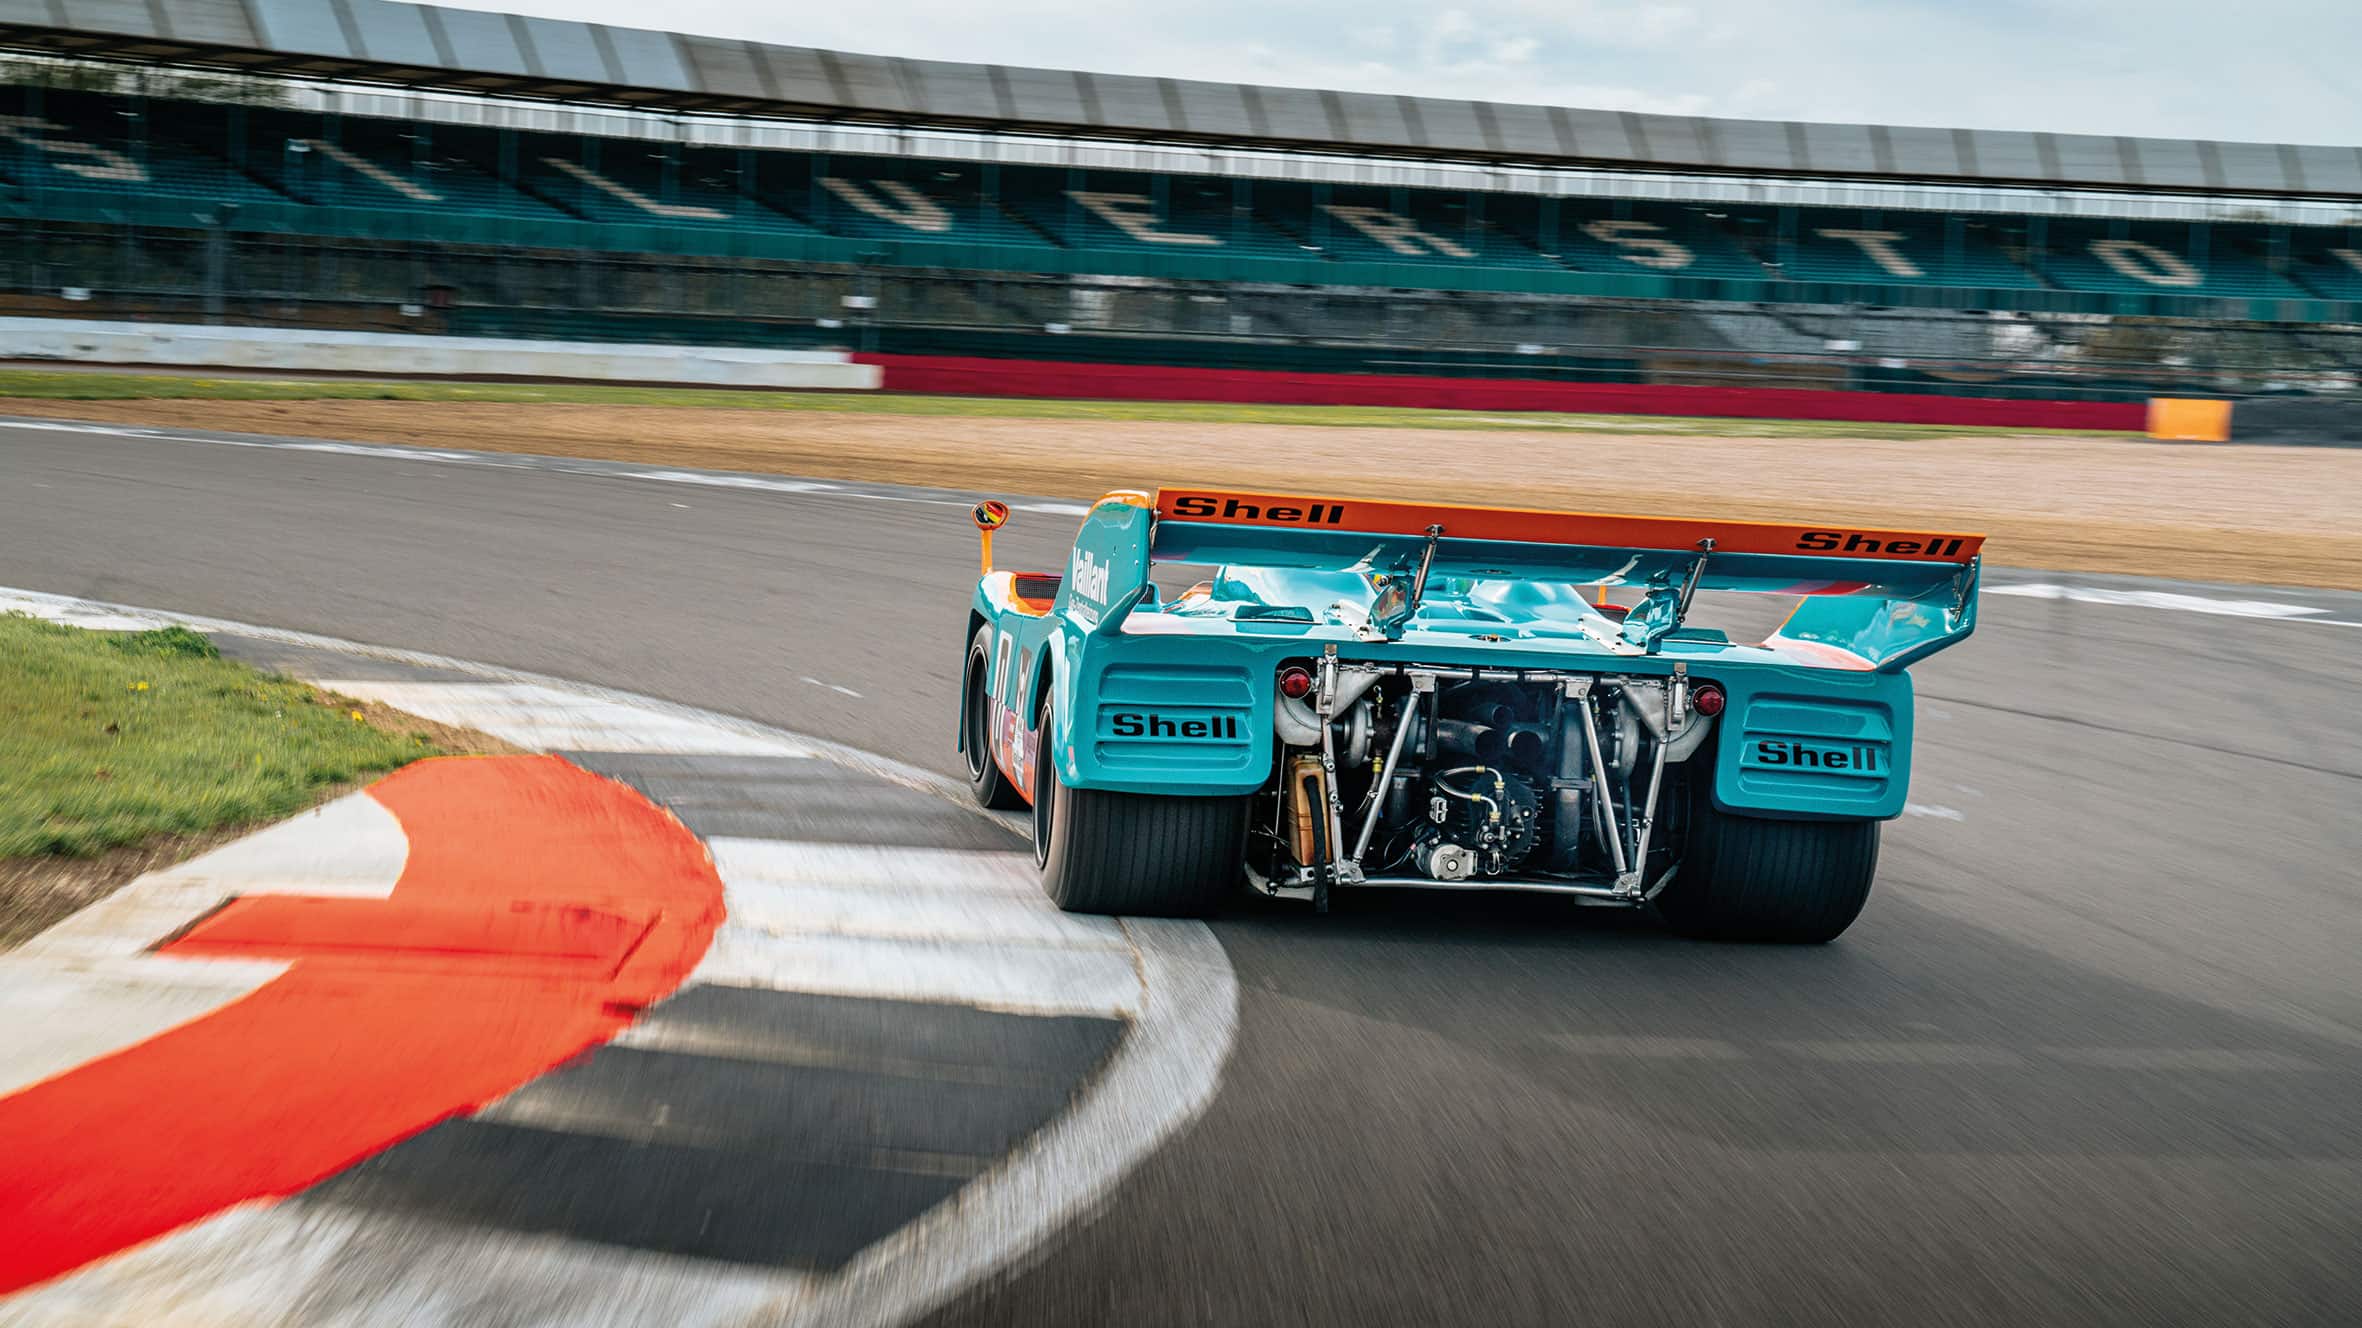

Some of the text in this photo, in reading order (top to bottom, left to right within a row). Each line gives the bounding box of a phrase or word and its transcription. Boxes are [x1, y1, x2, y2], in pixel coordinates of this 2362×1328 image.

[1173, 496, 1344, 524] Shell
[1796, 531, 1964, 557] Shell
[1072, 547, 1109, 606] Vaillant
[1113, 712, 1237, 739] Shell
[1758, 740, 1876, 771] Shell
